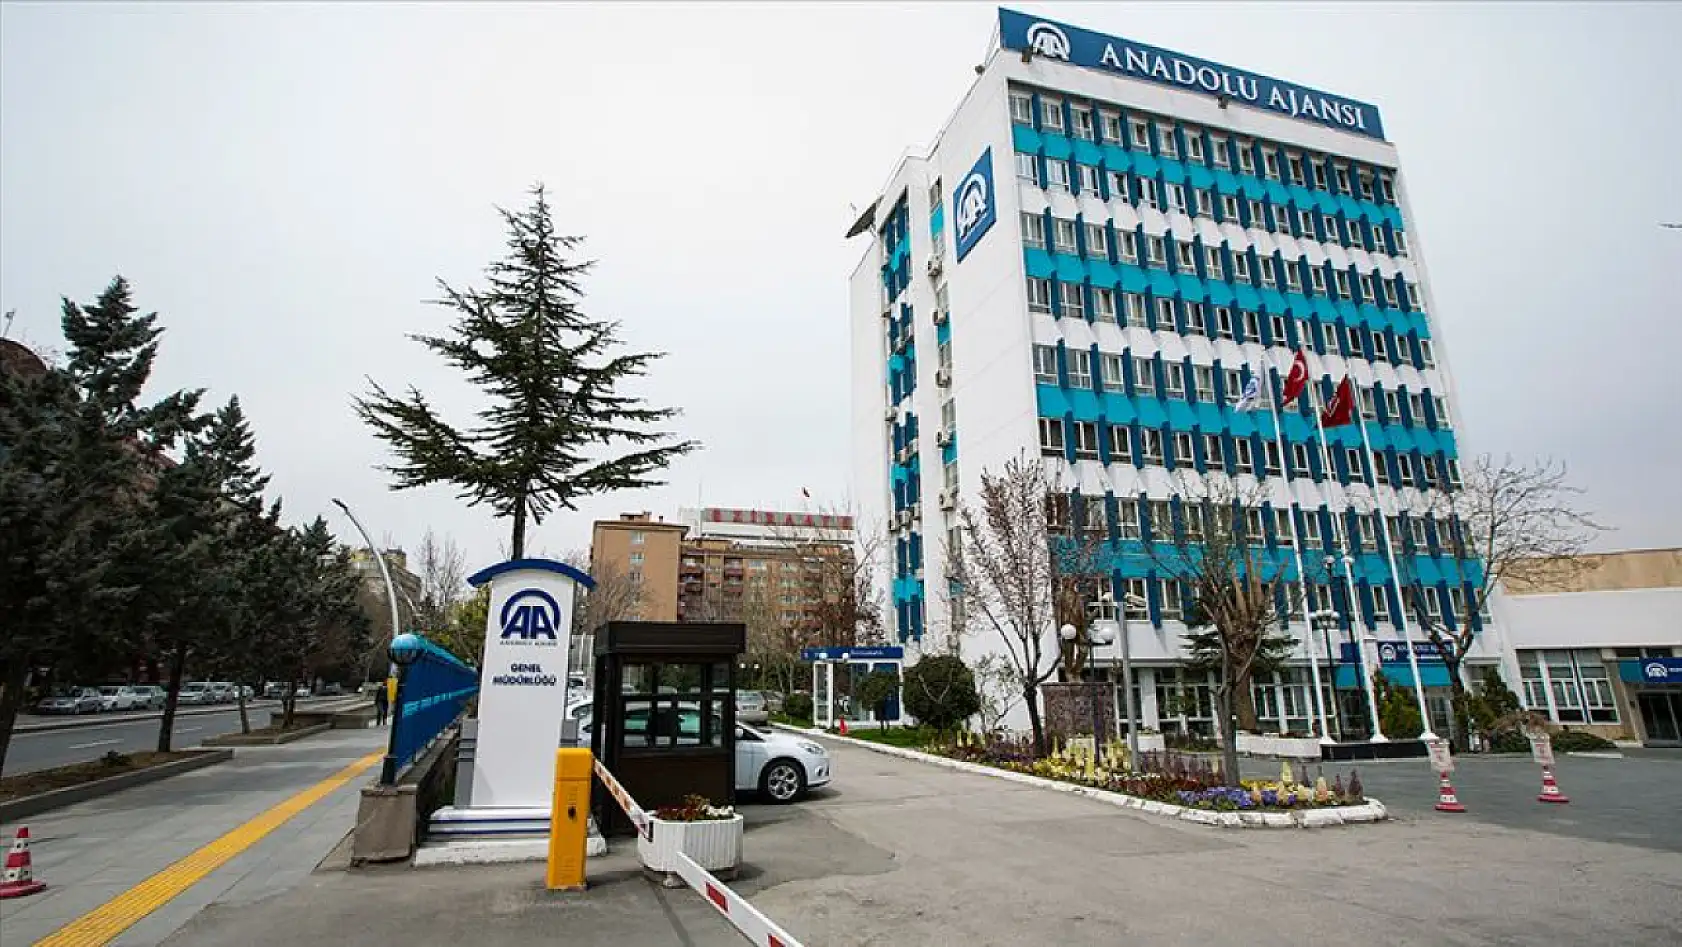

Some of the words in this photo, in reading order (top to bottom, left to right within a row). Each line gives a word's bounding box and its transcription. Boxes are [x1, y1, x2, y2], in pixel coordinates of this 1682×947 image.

[1100, 43, 1258, 101] ANADOLU
[1268, 86, 1368, 129] AJANSI
[501, 597, 558, 639] AA
[511, 663, 541, 673] GENEL
